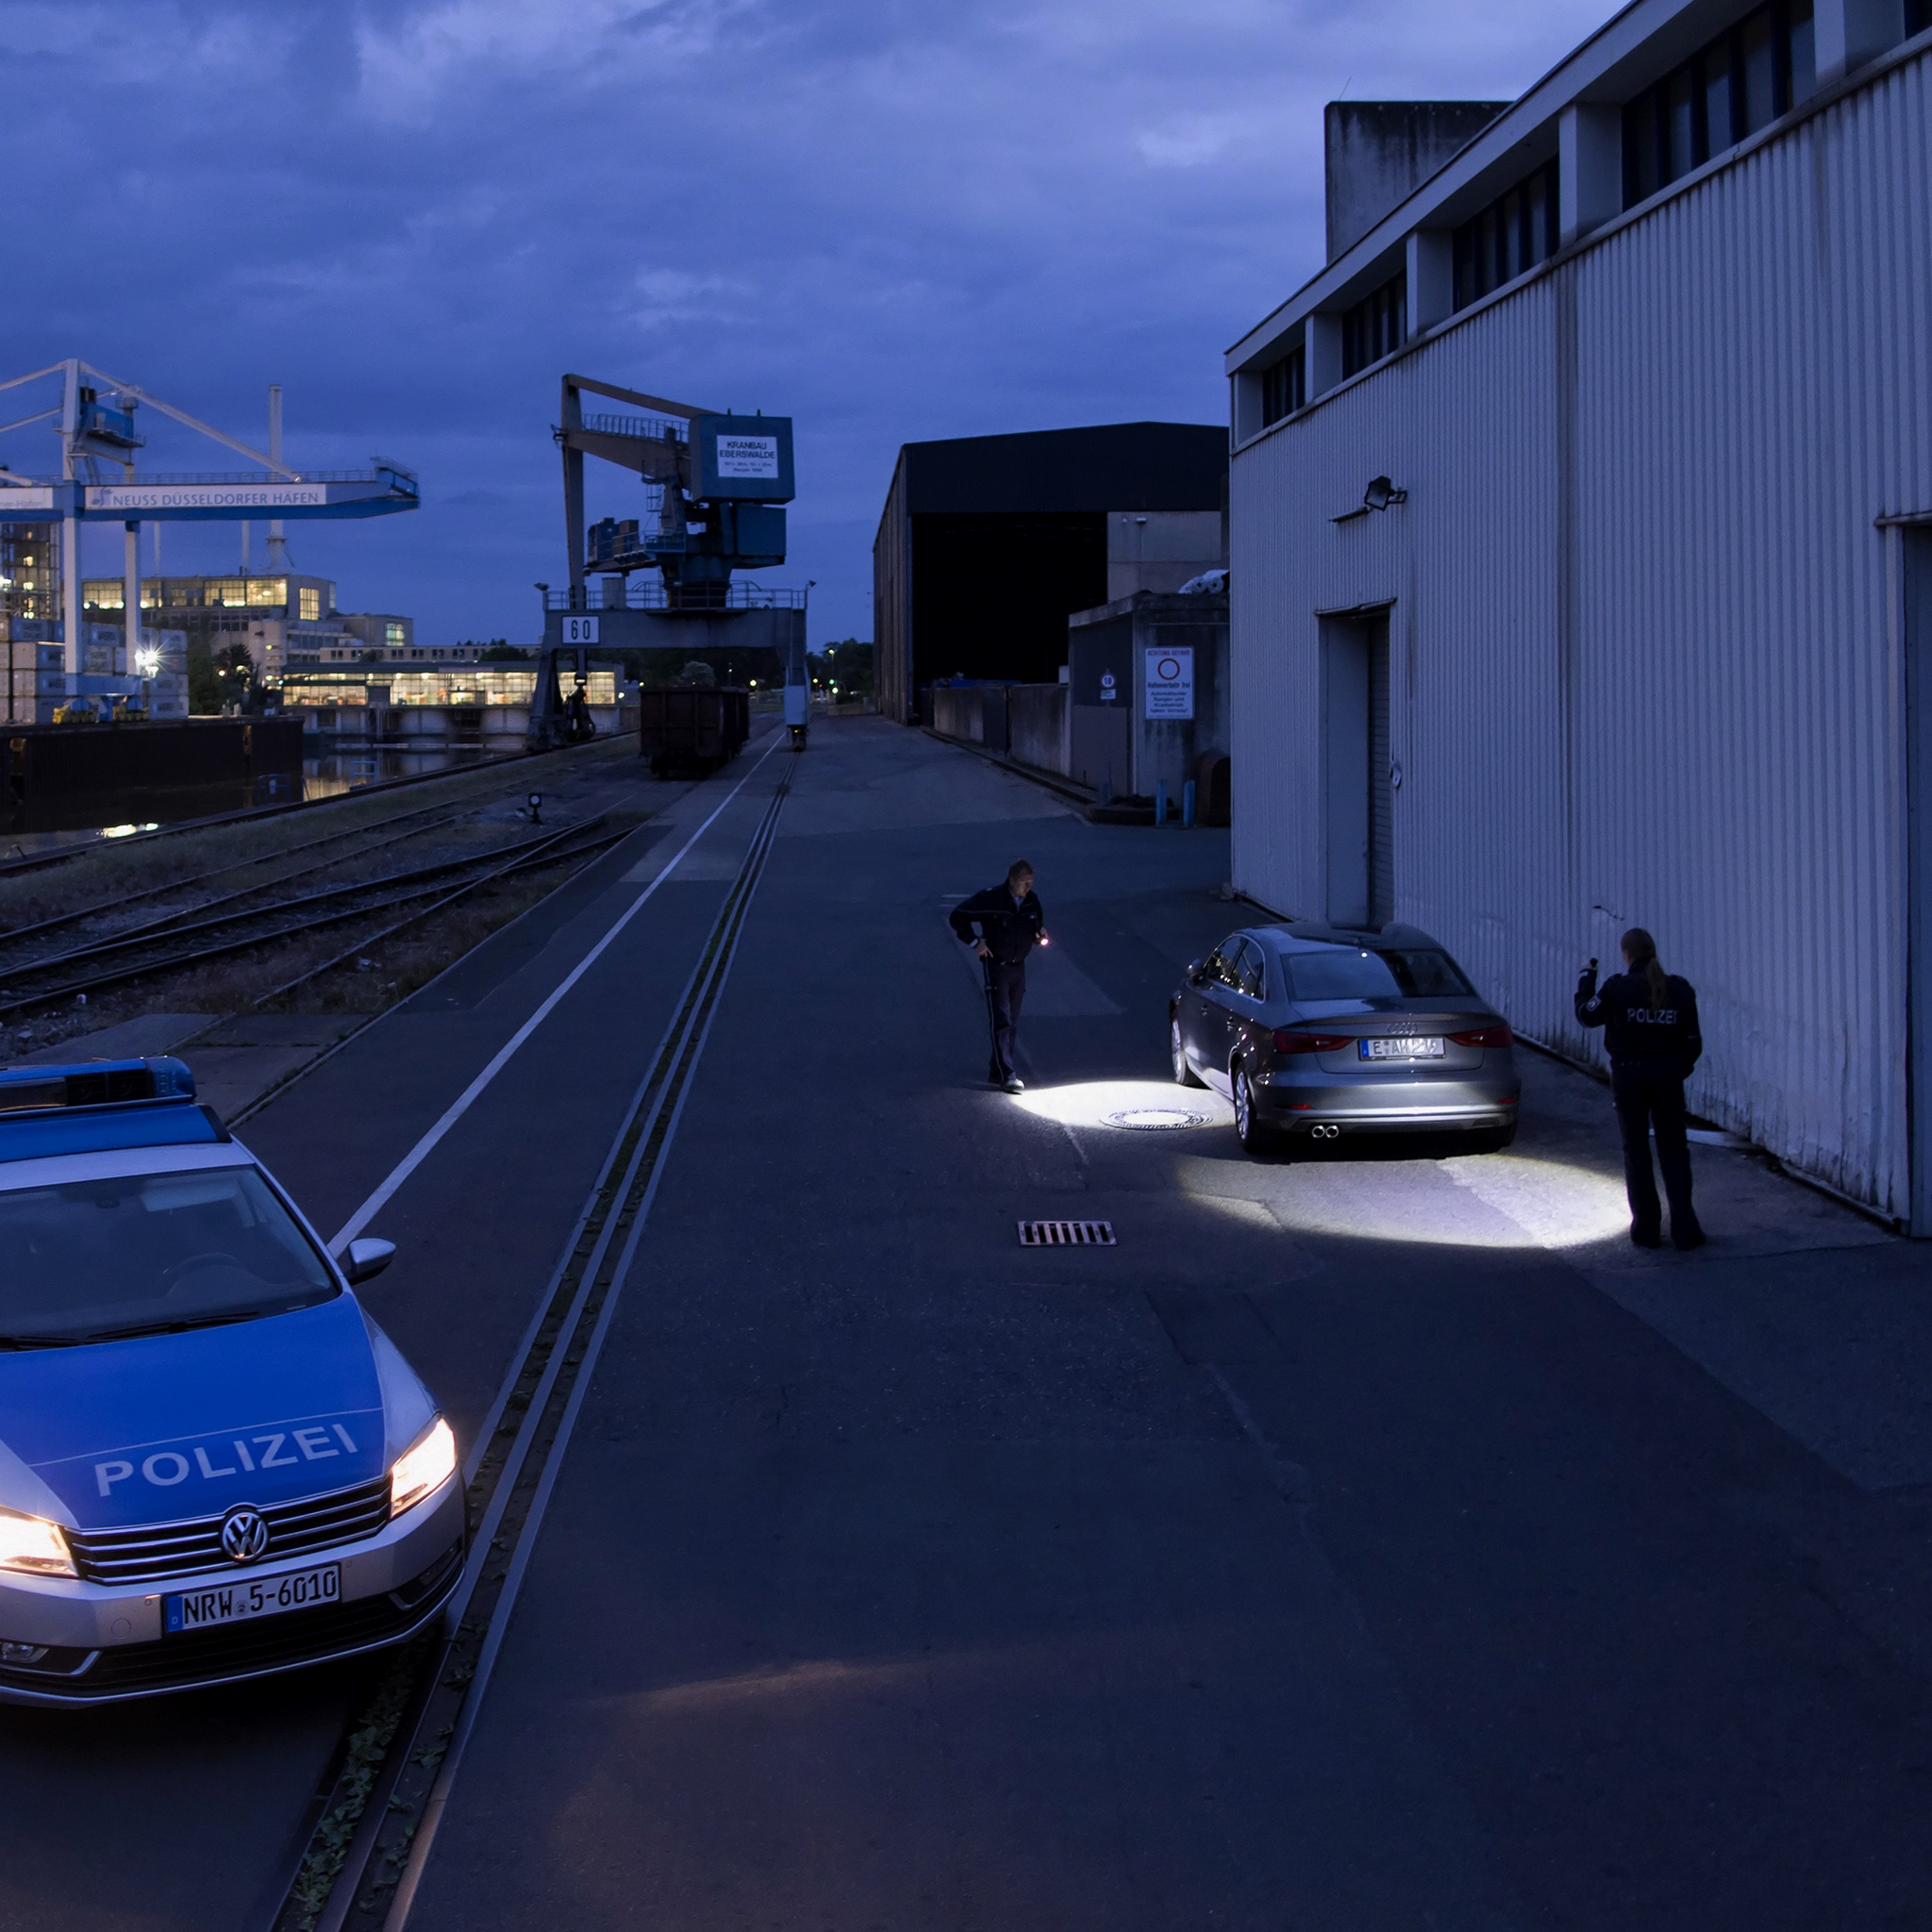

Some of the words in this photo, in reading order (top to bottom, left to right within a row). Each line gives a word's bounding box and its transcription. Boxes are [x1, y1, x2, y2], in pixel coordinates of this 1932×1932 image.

[720, 450, 775, 459] EBERSWALDE
[726, 441, 767, 450] KRANBAU
[113, 494, 157, 507] NEUSS
[162, 491, 267, 507] DÜSSELDORFER
[273, 491, 319, 505] HÄFEN
[571, 620, 591, 640] 60
[1626, 1007, 1679, 1025] POLIZEI
[1374, 1041, 1383, 1055] E
[94, 1424, 358, 1498] POLIZEI
[222, 1511, 265, 1562] VW
[183, 1590, 233, 1625] NRW
[249, 1570, 338, 1613] 5-6010
